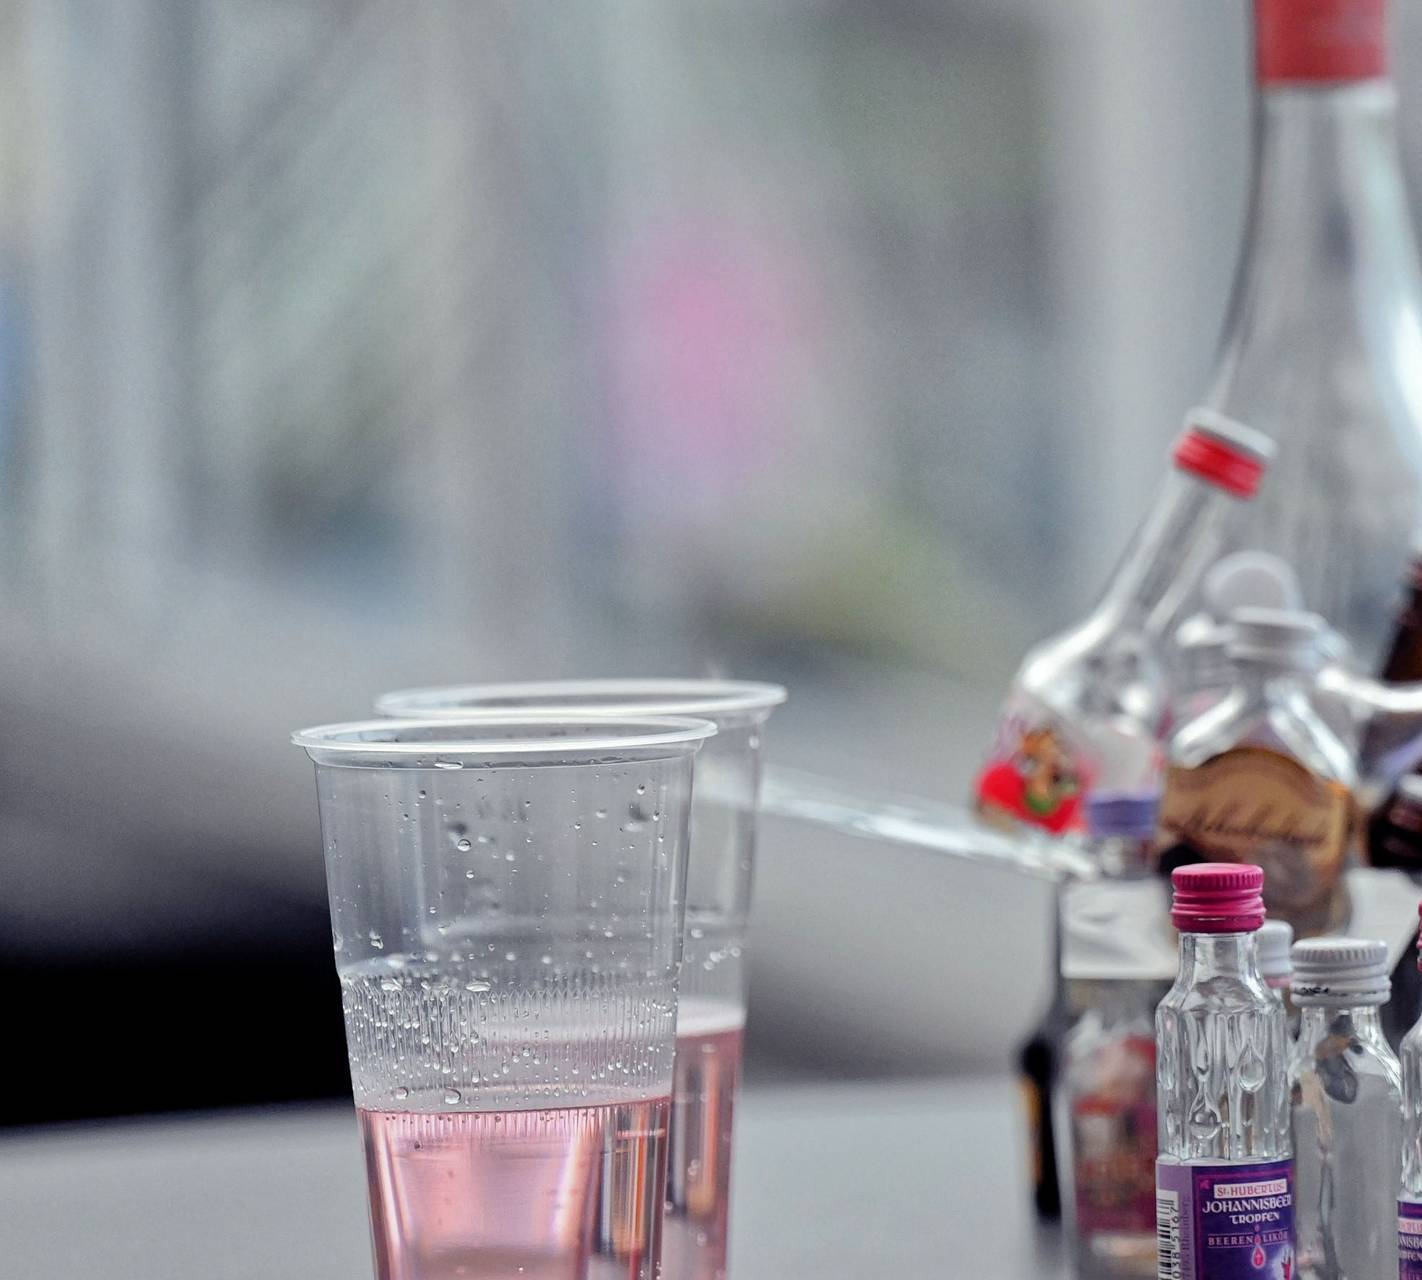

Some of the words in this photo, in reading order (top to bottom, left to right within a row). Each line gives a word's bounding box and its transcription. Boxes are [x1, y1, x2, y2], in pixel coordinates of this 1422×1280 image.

[1171, 1206, 1180, 1243] 5167
[1229, 1212, 1280, 1225] TROPFEN
[1207, 1236, 1254, 1246] BEEREN
